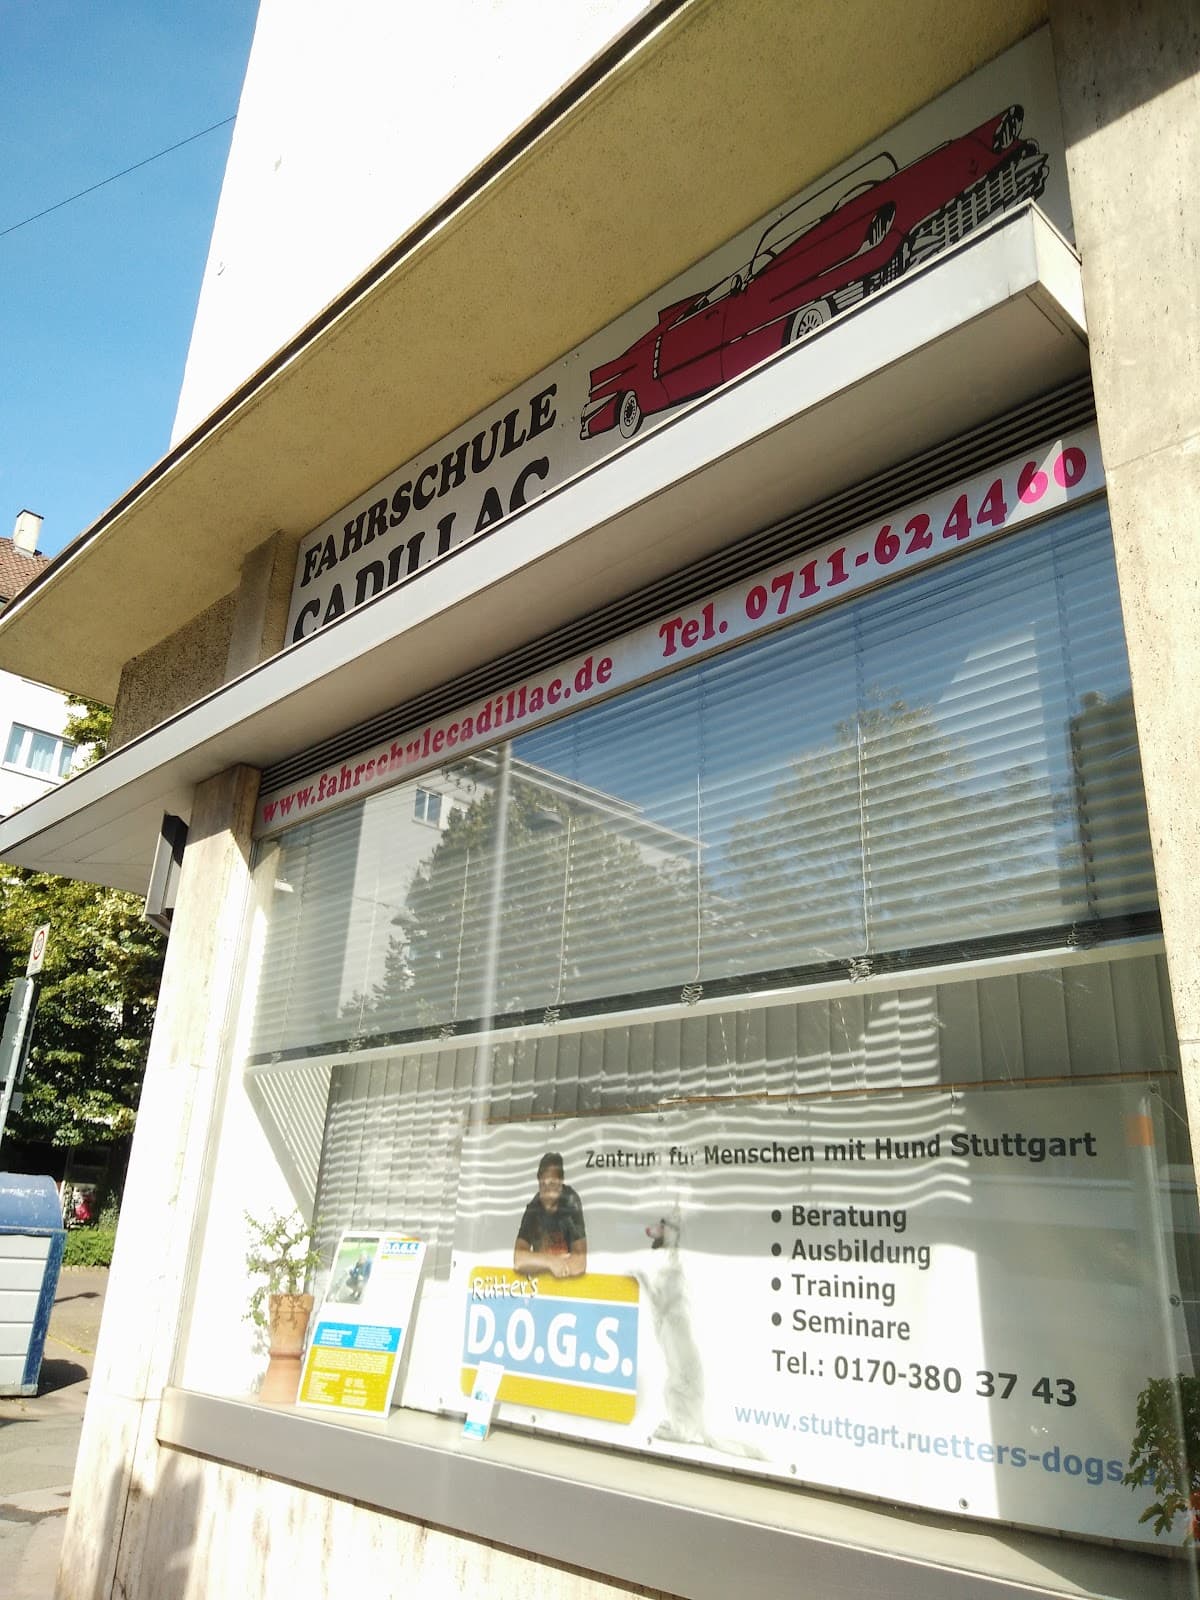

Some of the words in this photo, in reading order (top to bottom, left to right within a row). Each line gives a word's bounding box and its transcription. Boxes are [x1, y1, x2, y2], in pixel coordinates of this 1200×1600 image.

[300, 384, 557, 588] FAHRSCHULE
[263, 656, 613, 823] www.fahrschulecadillac.de
[659, 603, 728, 657] Tel.
[704, 1143, 815, 1166] Menschen
[824, 1140, 867, 1161] mit
[874, 1133, 941, 1160] Hund
[950, 1131, 1097, 1162] Stuttgart
[791, 1205, 908, 1233] Beratung
[791, 1239, 931, 1270] Ausbildung
[471, 1274, 539, 1301] Rütter's
[791, 1273, 895, 1306] Training
[467, 1303, 634, 1377] D.O.G.S.
[791, 1308, 911, 1341] Seminare
[772, 1349, 824, 1377] Tel.:
[833, 1356, 962, 1393] 0170-380
[975, 1370, 1018, 1400] 37
[1031, 1376, 1077, 1408] 43
